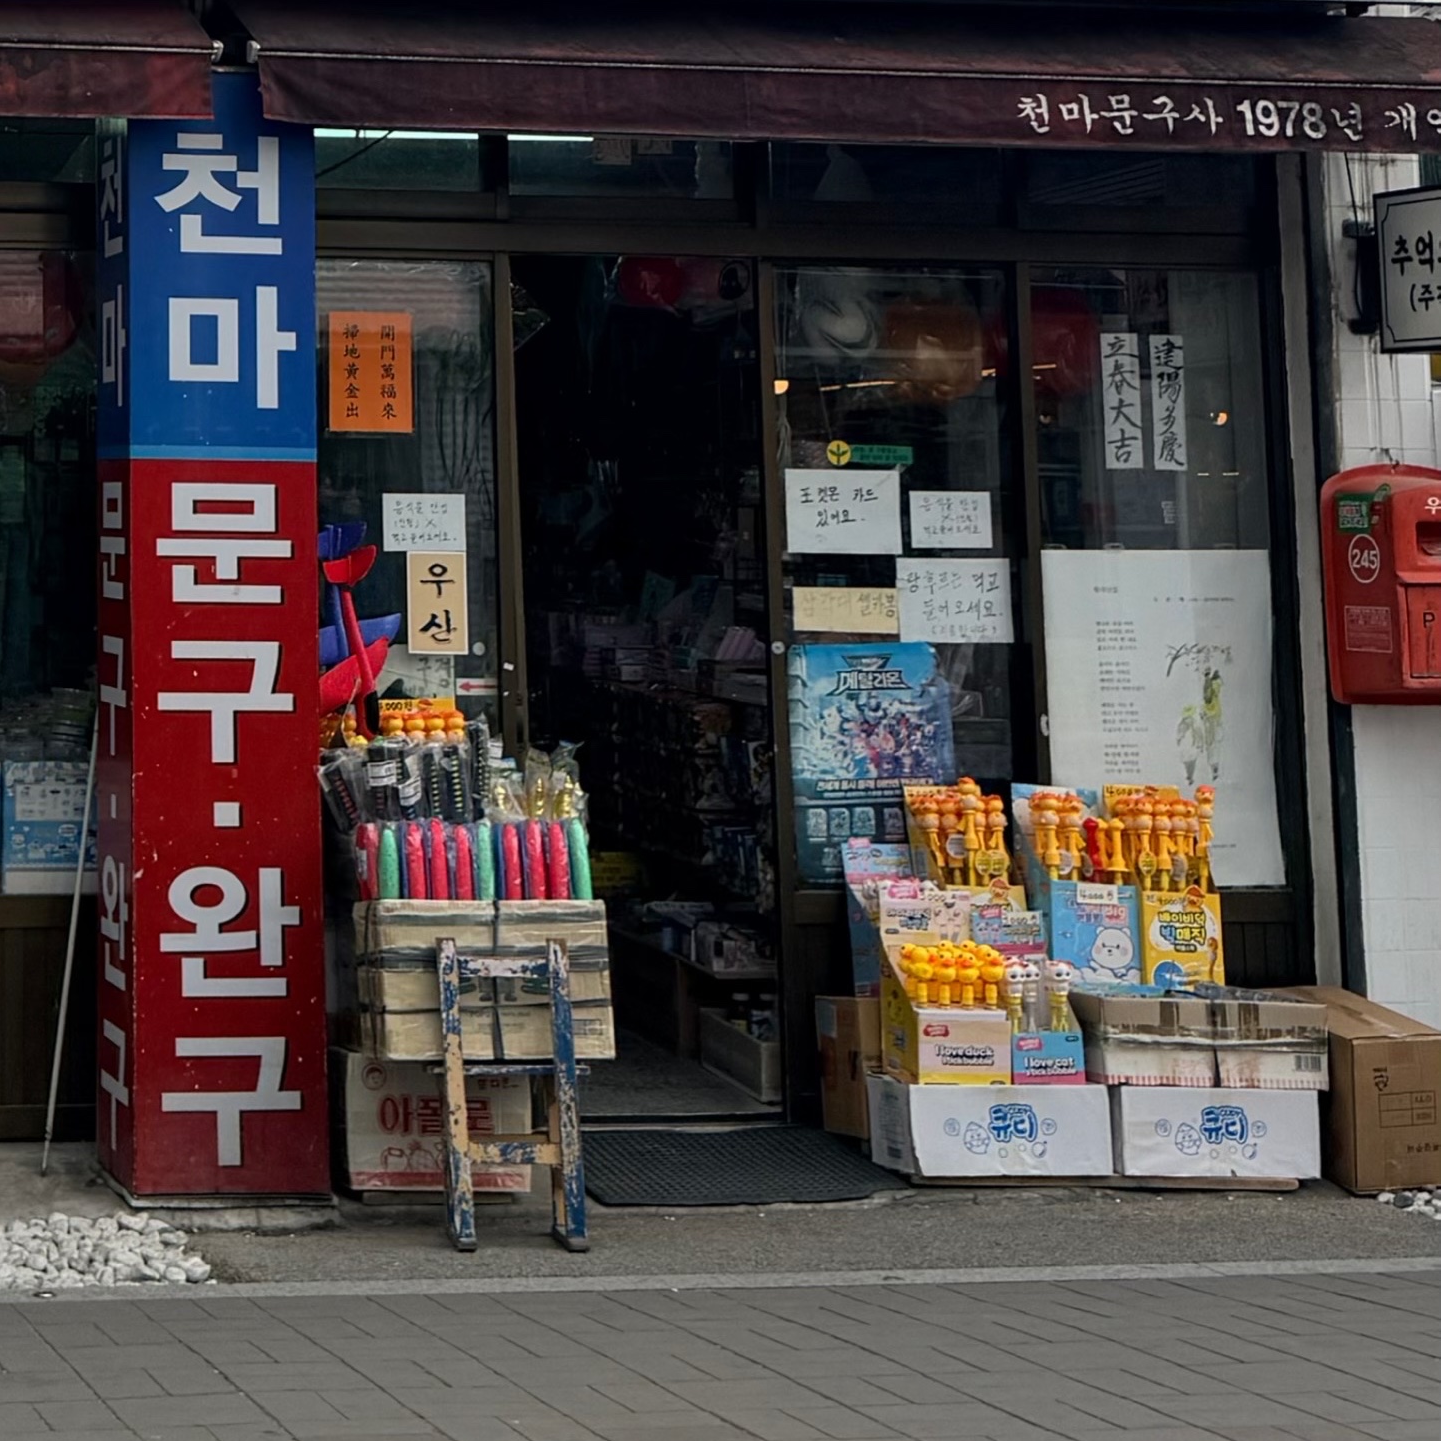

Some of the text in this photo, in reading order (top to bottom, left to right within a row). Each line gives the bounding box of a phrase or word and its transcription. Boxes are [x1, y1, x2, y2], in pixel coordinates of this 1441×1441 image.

[1018, 93, 1223, 134] 천마문구사
[1236, 99, 1364, 141] 1978년
[154, 133, 297, 409] 천마
[1391, 230, 1441, 277] 추억
[1102, 336, 1142, 464] 立春大吉
[852, 486, 879, 503] 카드
[1352, 548, 1379, 570] 245
[419, 562, 458, 644] 우산
